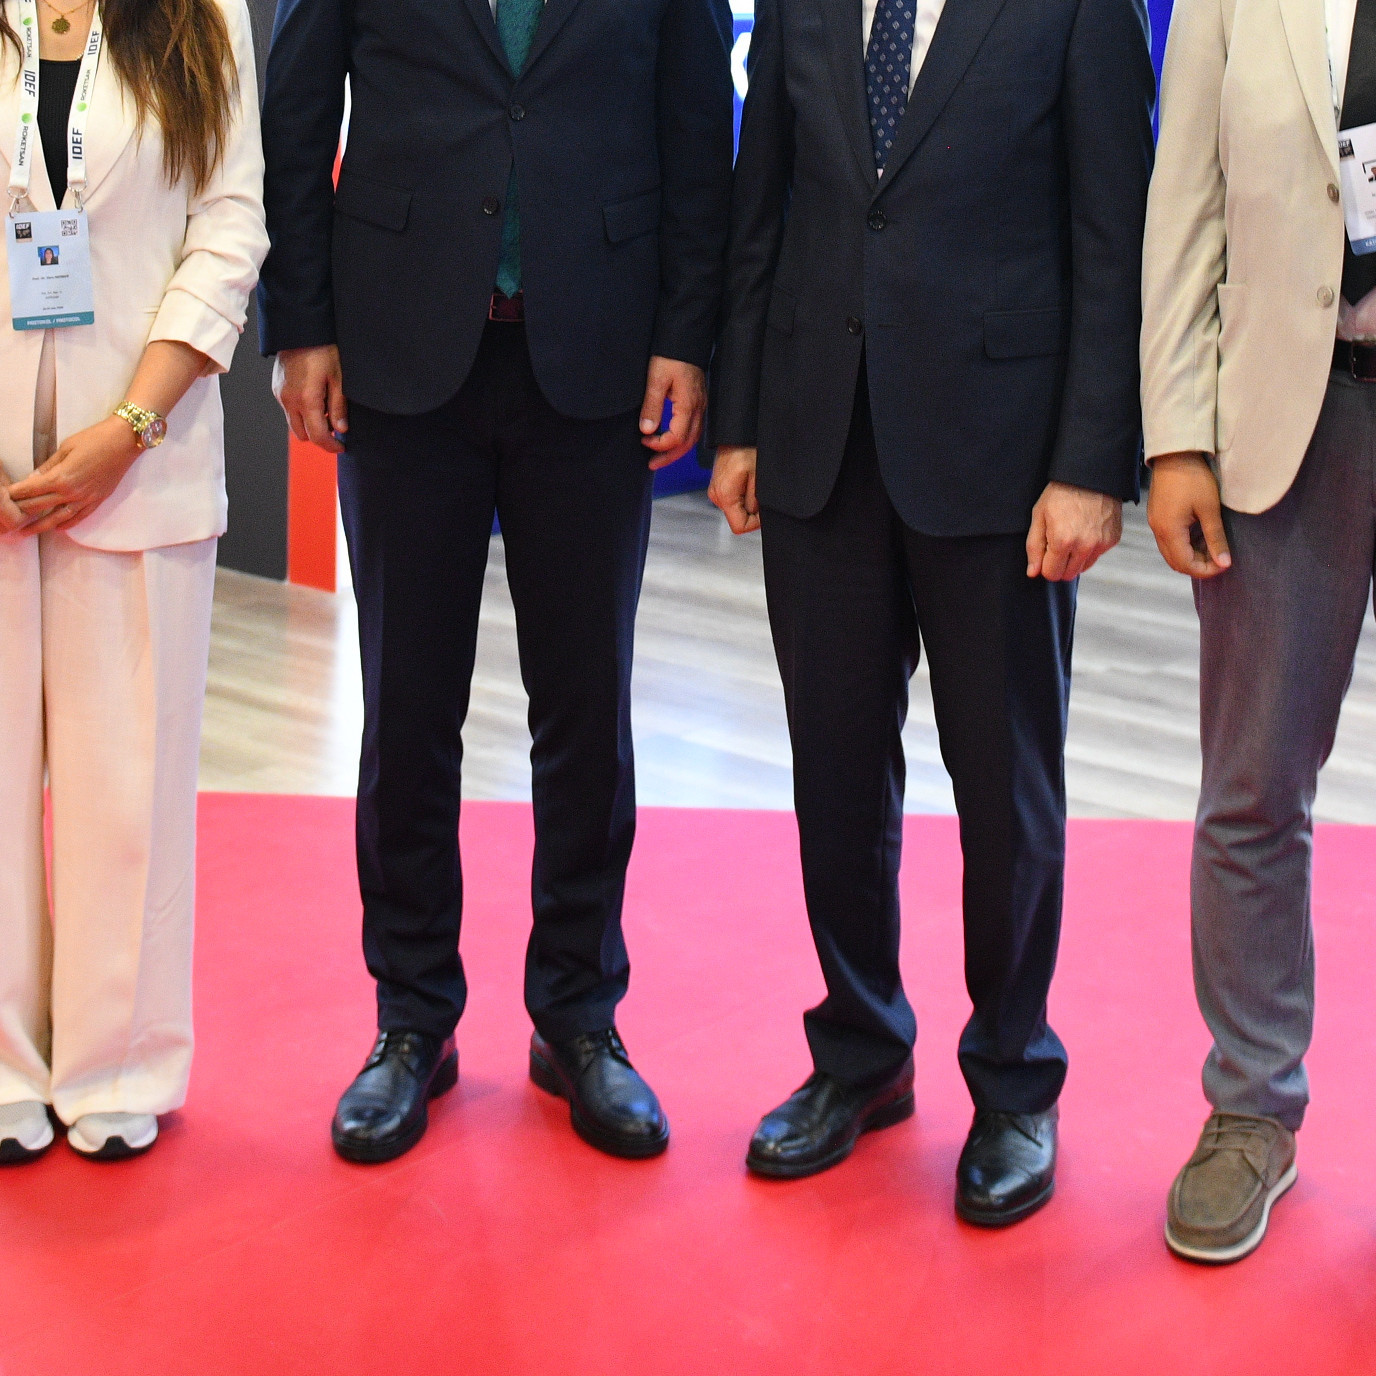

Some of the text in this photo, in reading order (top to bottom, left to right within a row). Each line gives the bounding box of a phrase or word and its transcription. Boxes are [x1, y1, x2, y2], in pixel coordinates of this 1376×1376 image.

[24, 69, 36, 98] IDEF
[72, 127, 84, 160] IDEF
[87, 30, 100, 56] IDEF
[18, 125, 29, 167] ROKETSAN
